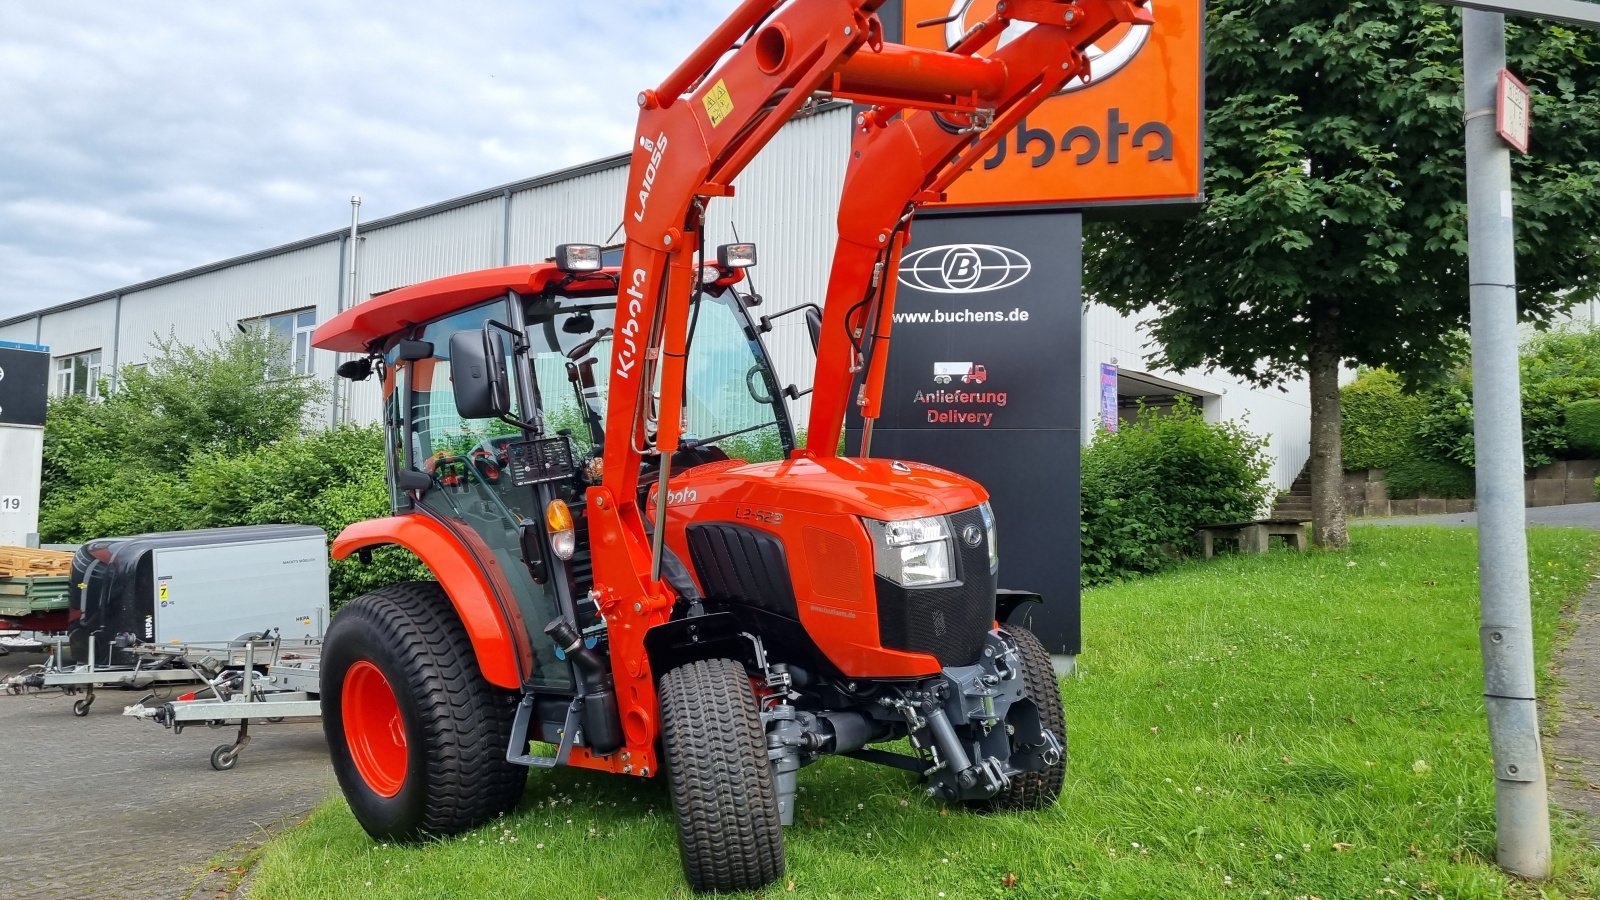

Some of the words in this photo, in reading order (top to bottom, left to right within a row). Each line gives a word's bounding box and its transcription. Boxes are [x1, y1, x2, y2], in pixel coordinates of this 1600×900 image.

[951, 108, 1174, 170] ubota
[634, 131, 668, 223] LA1055
[616, 268, 647, 379] Kubota
[892, 308, 1029, 323] www.buchens.de
[913, 389, 1008, 407] Anlieferung
[927, 409, 993, 426] Delivery
[3, 498, 20, 509] 19
[651, 486, 697, 505] Kbota
[161, 588, 167, 596] 7
[145, 616, 153, 639] HKPA
